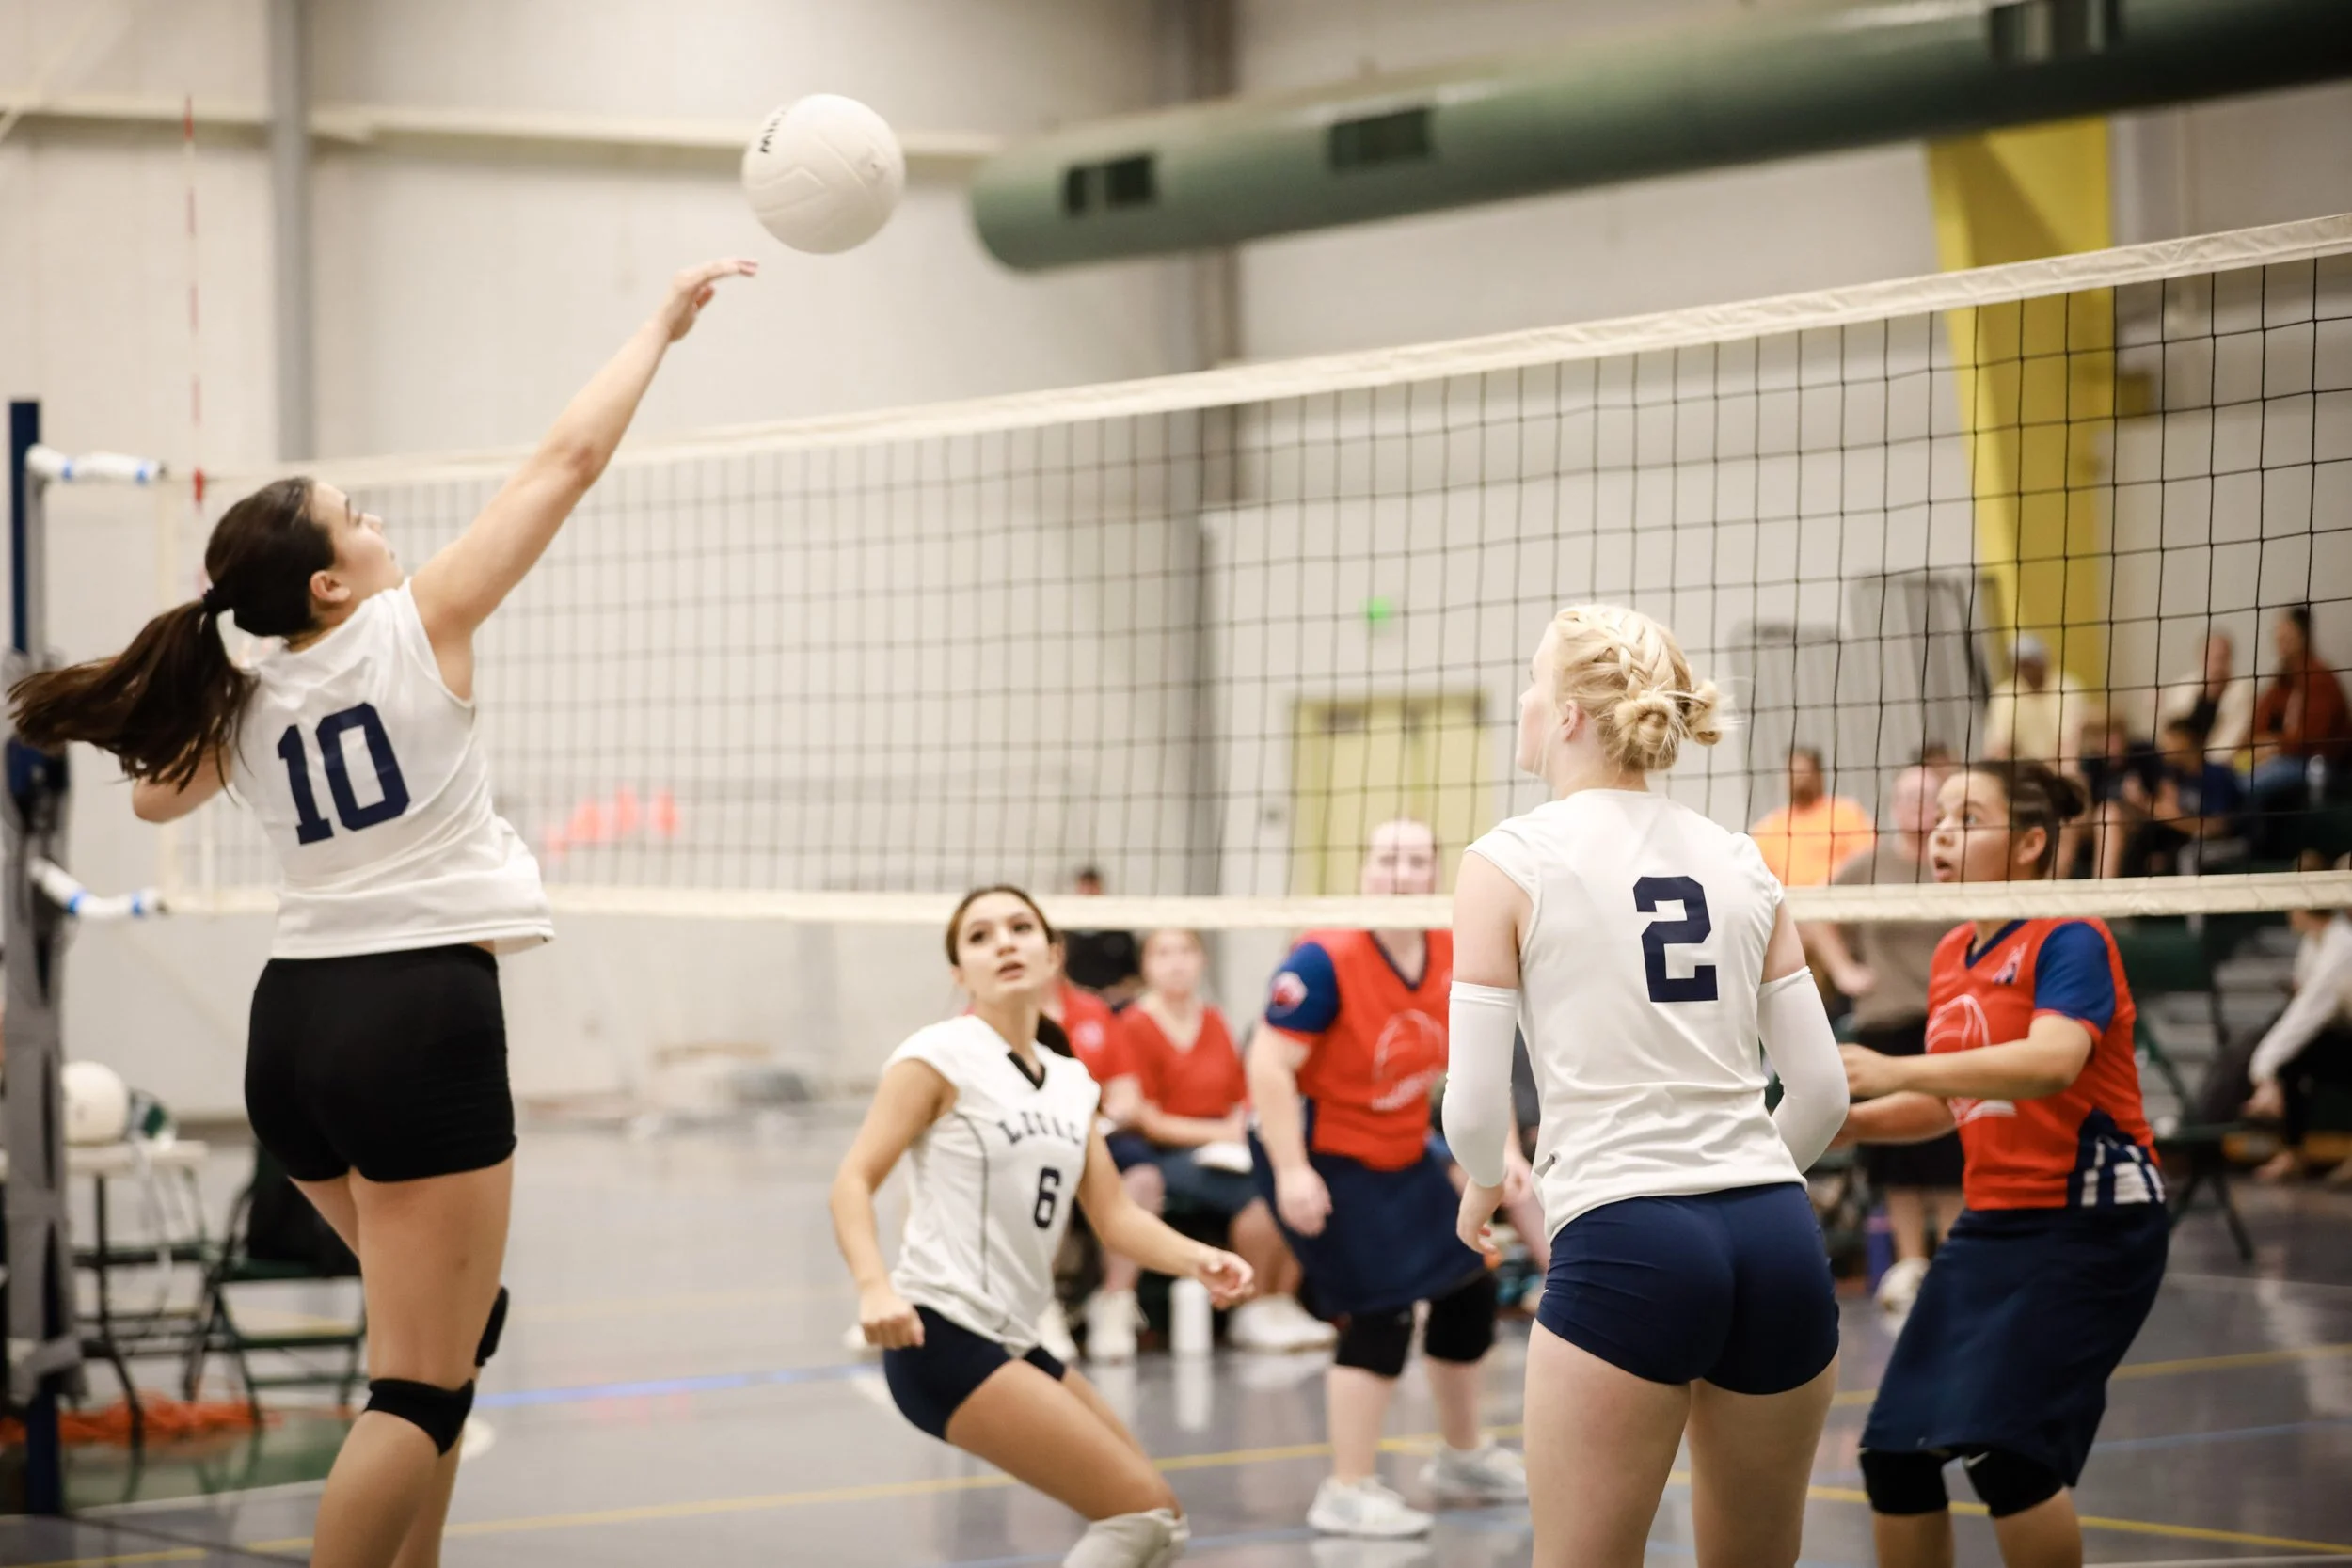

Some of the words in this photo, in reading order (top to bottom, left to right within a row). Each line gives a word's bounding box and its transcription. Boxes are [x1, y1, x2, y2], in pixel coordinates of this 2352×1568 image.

[278, 702, 410, 845] 10
[1633, 876, 1718, 1002] 2
[1034, 1166, 1060, 1229] 6
